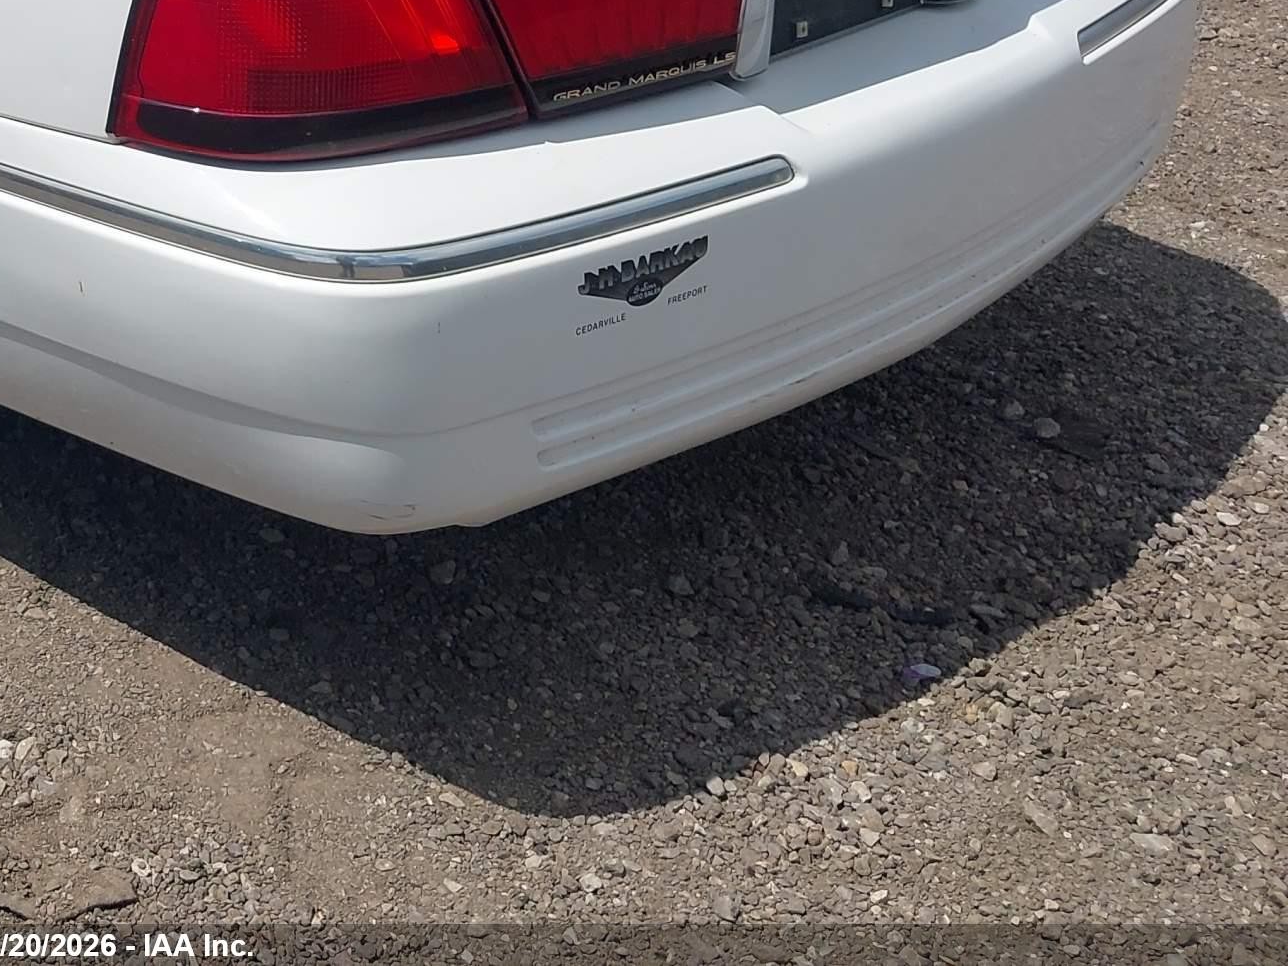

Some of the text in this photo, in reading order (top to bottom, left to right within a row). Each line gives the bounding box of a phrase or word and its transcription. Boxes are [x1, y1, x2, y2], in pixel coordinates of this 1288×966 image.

[552, 51, 737, 102] GRAND MARQUIS LS
[667, 285, 708, 306] FREEPORT
[575, 312, 627, 337] CEDARVILLE
